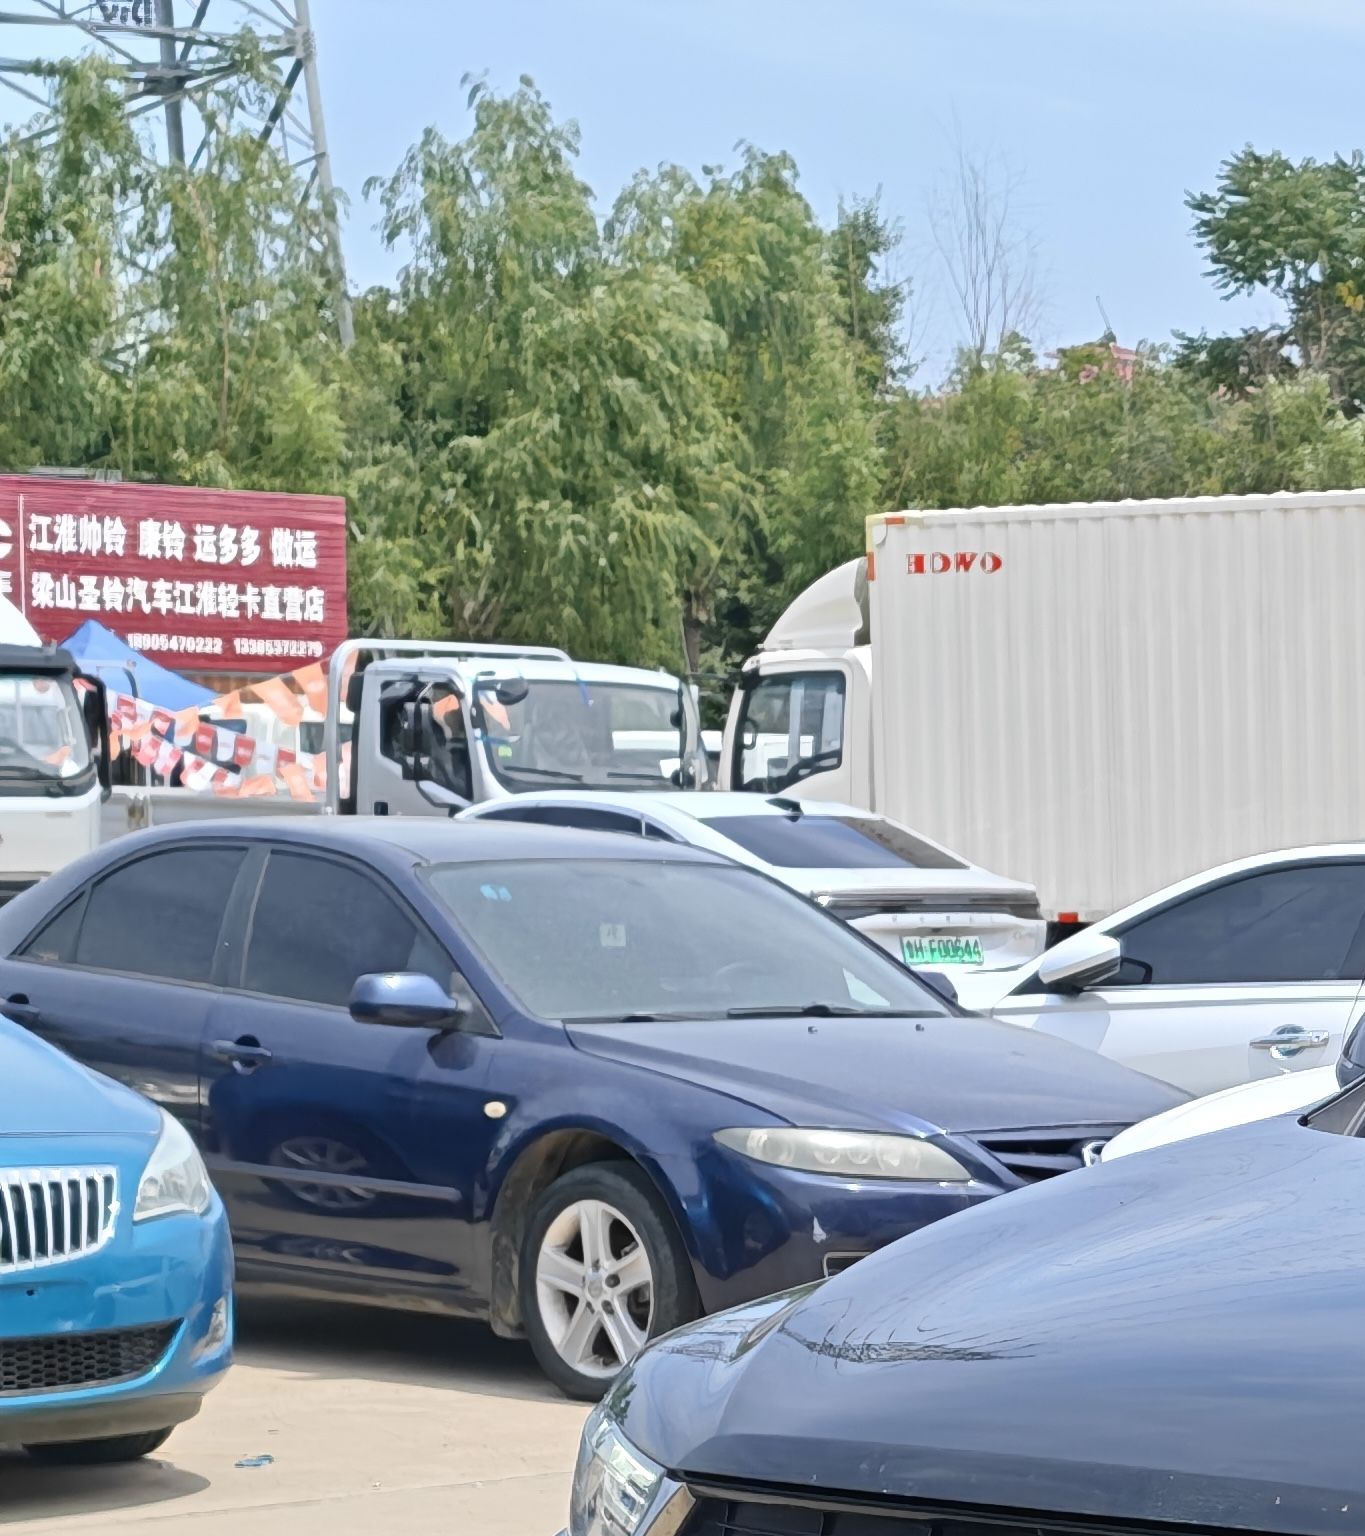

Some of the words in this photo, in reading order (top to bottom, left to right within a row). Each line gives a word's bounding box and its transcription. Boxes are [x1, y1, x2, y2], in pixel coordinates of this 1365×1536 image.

[29, 513, 127, 557] 江淮帅铃
[137, 517, 186, 562] 康铃
[193, 523, 261, 567] 运多多
[906, 551, 1003, 575] HOWO
[31, 570, 325, 623] 梁山圣铃汽车江淮轻卡直营店
